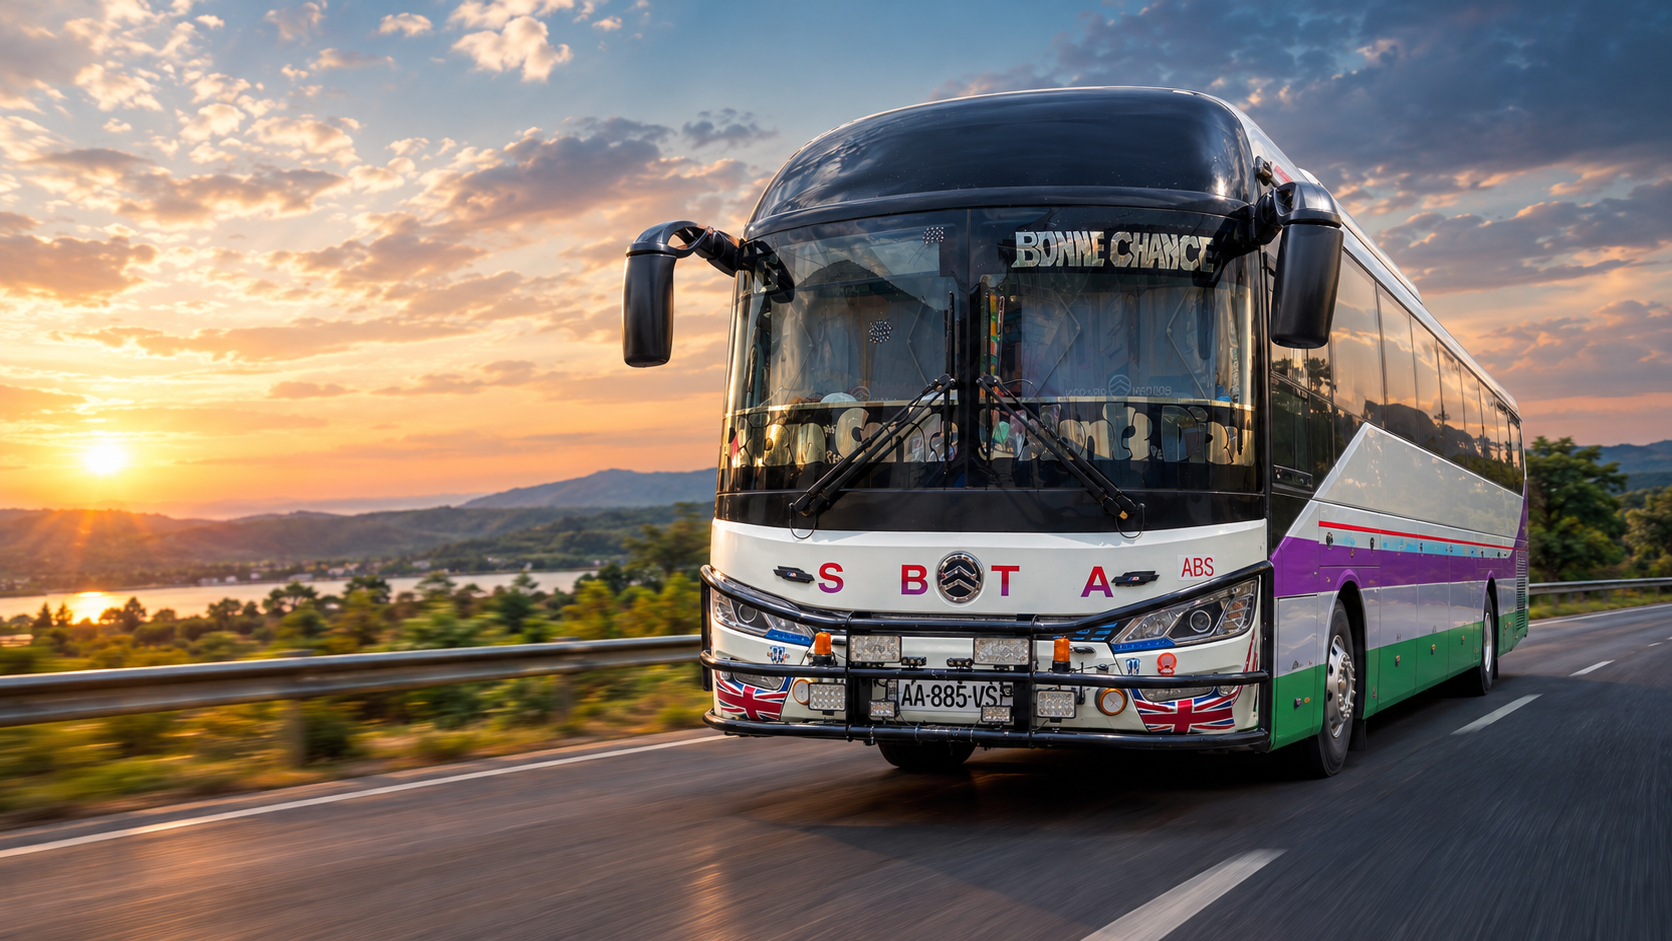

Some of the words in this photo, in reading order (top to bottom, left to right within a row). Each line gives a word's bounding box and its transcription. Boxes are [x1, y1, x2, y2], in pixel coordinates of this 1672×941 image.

[1011, 231, 1105, 268] BONNE
[1181, 557, 1214, 577] ABS
[901, 684, 998, 708] AA-885-VS
